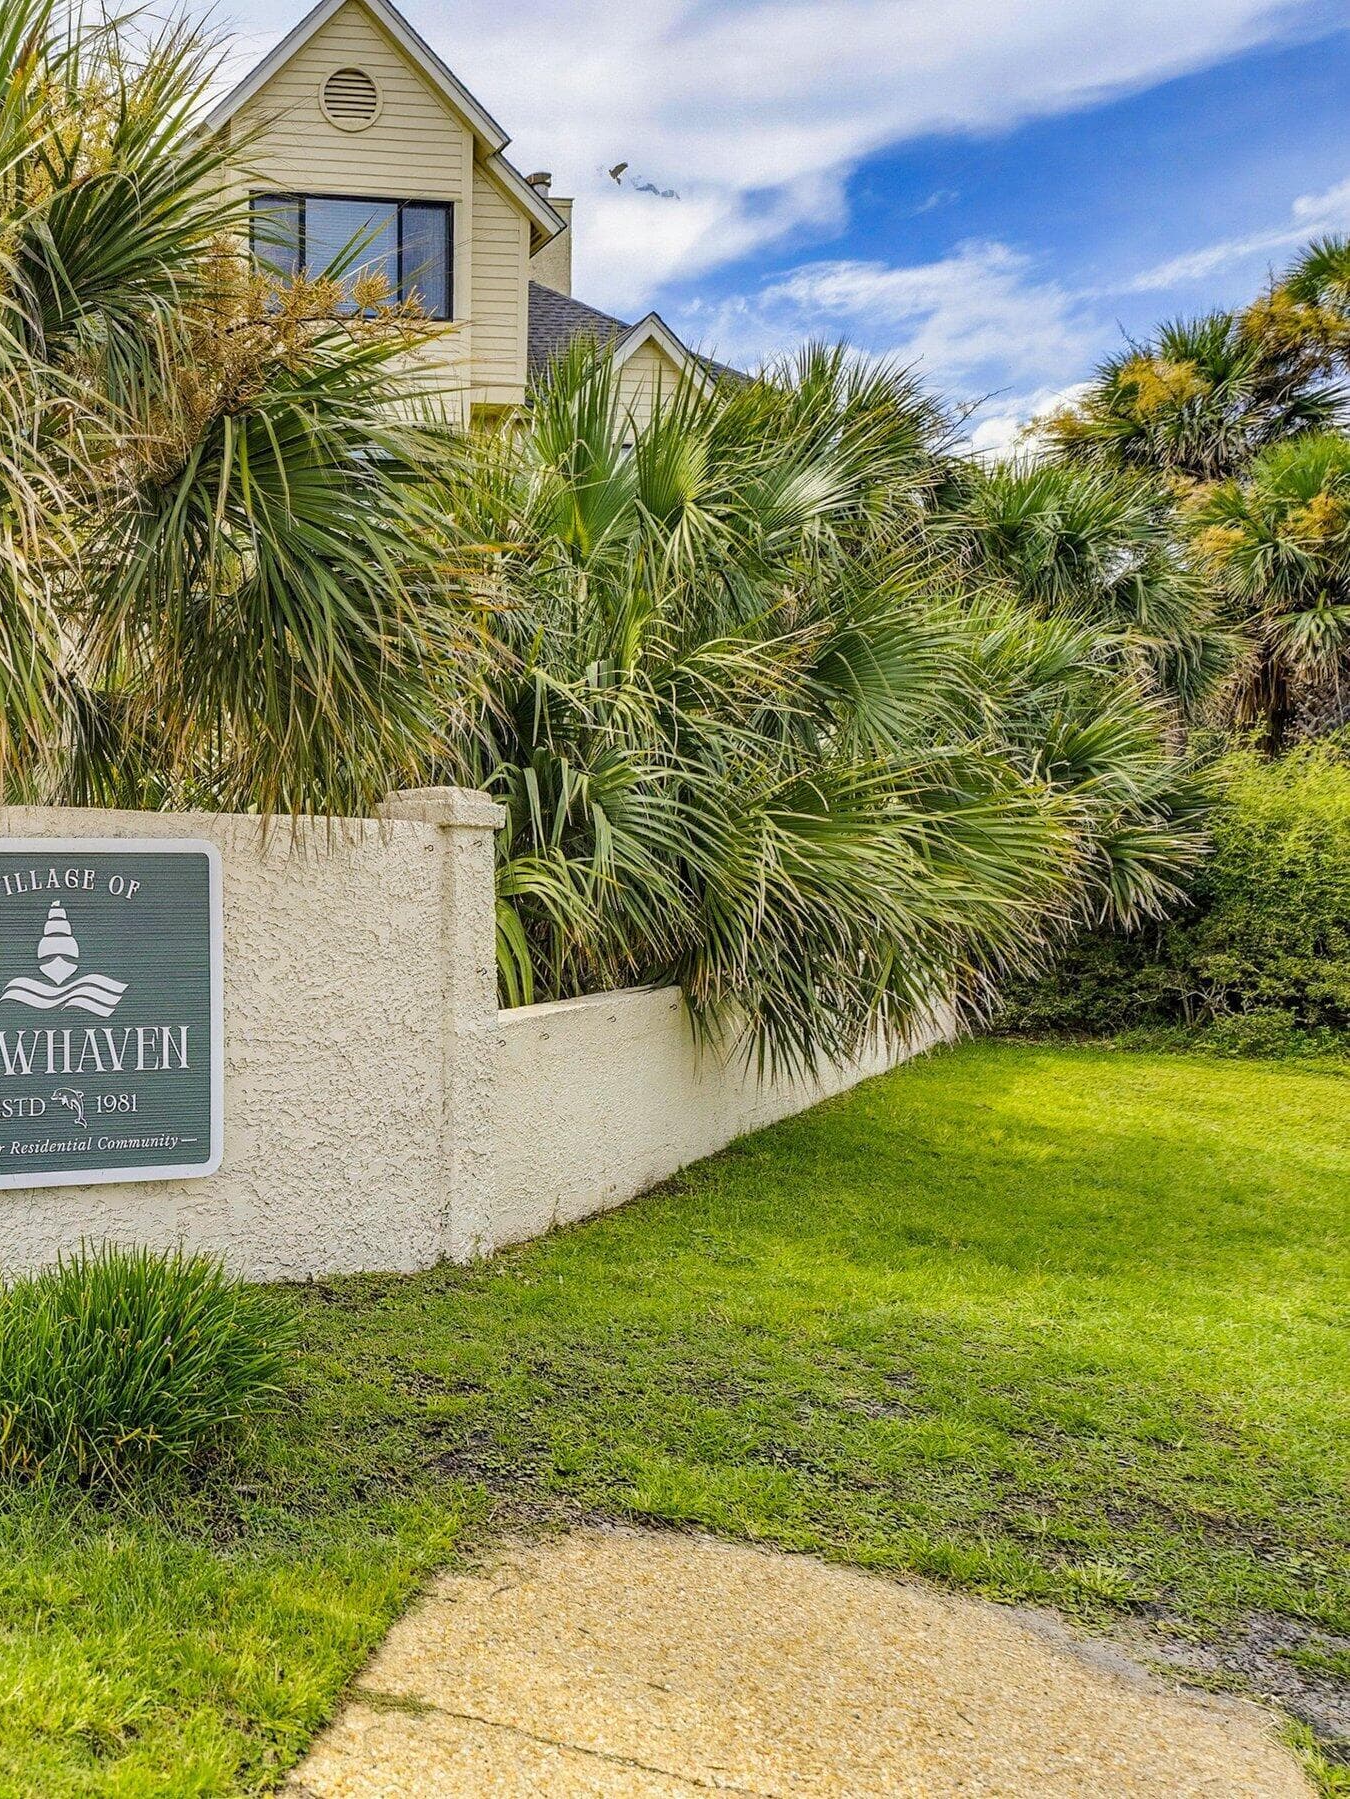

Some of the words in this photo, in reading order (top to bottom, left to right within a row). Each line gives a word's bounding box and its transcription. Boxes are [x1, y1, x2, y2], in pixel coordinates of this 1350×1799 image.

[108, 875, 140, 900] OF
[96, 1094, 138, 1114] 1981
[10, 1136, 92, 1155] Residential
[98, 1133, 179, 1150] Community
